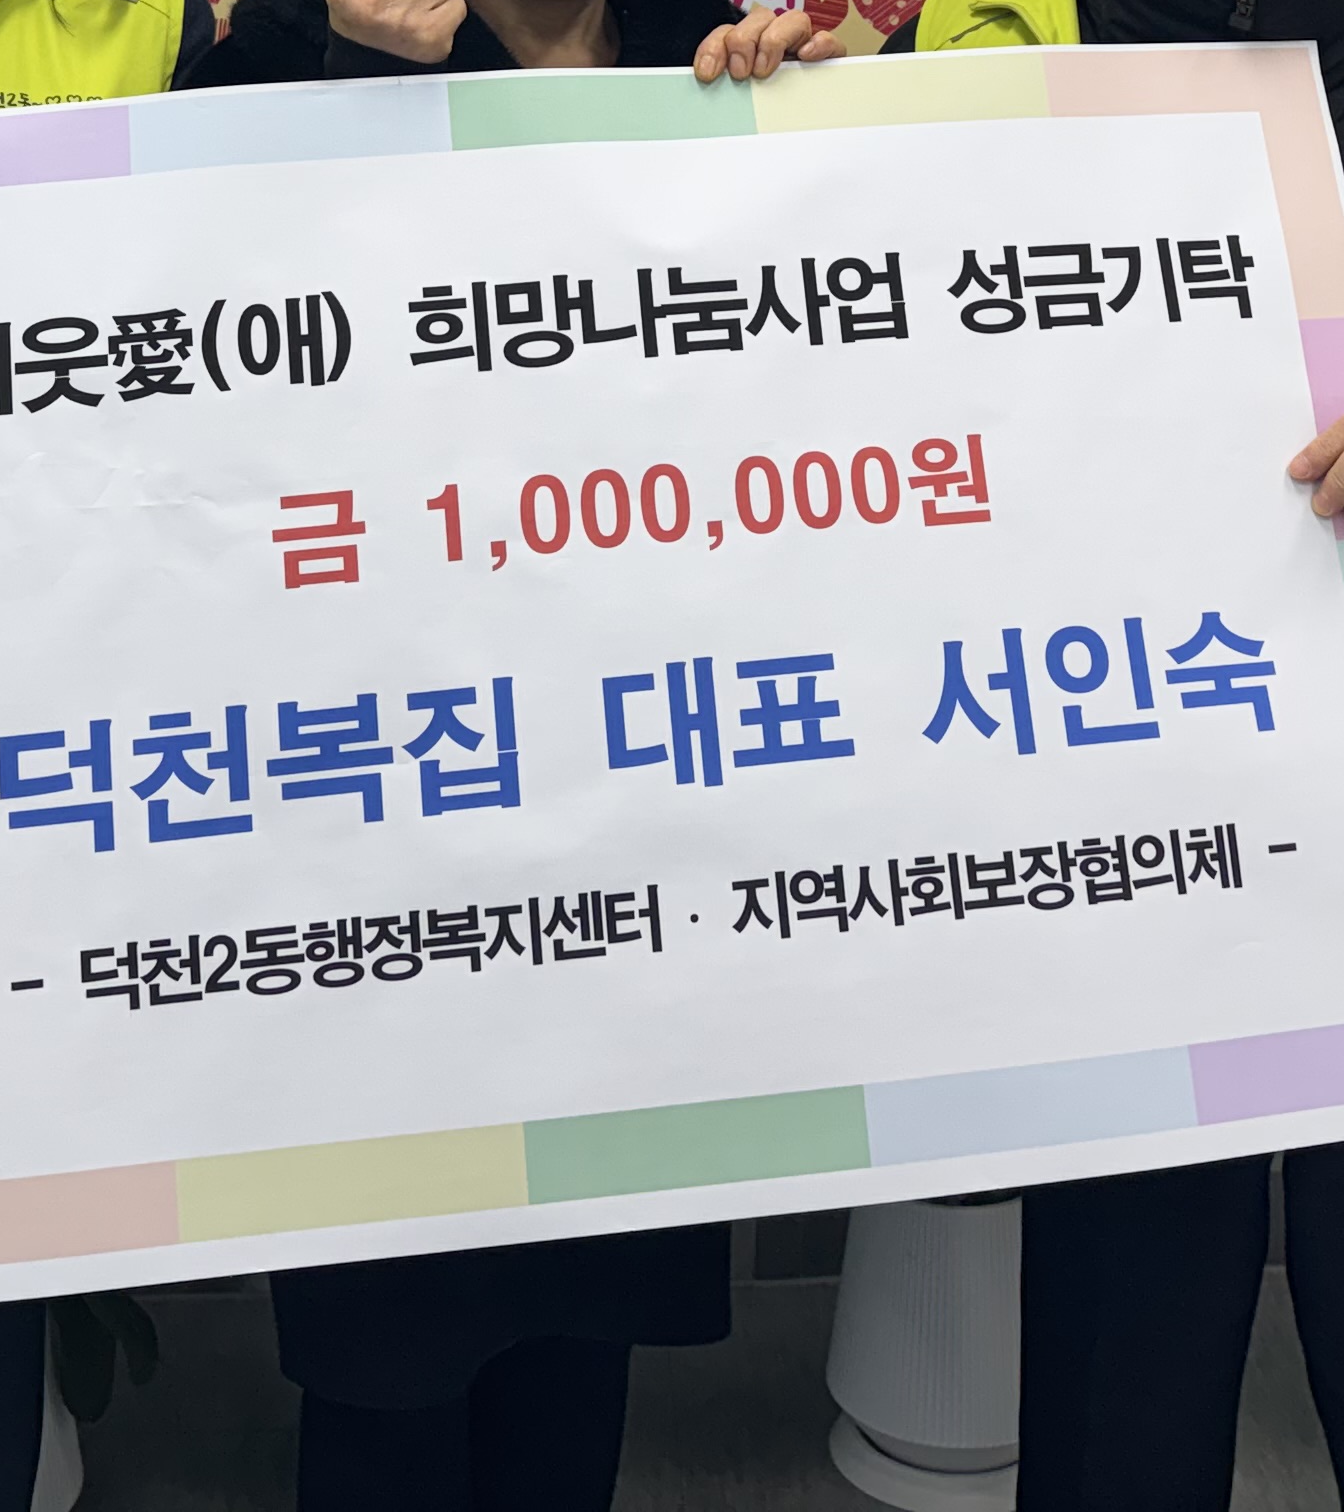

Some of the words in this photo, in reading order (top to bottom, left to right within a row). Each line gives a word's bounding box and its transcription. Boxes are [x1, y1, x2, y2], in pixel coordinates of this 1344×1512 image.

[407, 252, 910, 373] 희망나눔사업
[946, 235, 1255, 335] 성금기탁
[271, 489, 367, 589] 금
[426, 434, 992, 571] 1,000,000원
[601, 652, 856, 787] 대표
[921, 612, 1277, 756] 서인숙
[79, 884, 663, 1011] 덕천2동행정복지센터
[731, 823, 1243, 940] 지역사회보장협의체
